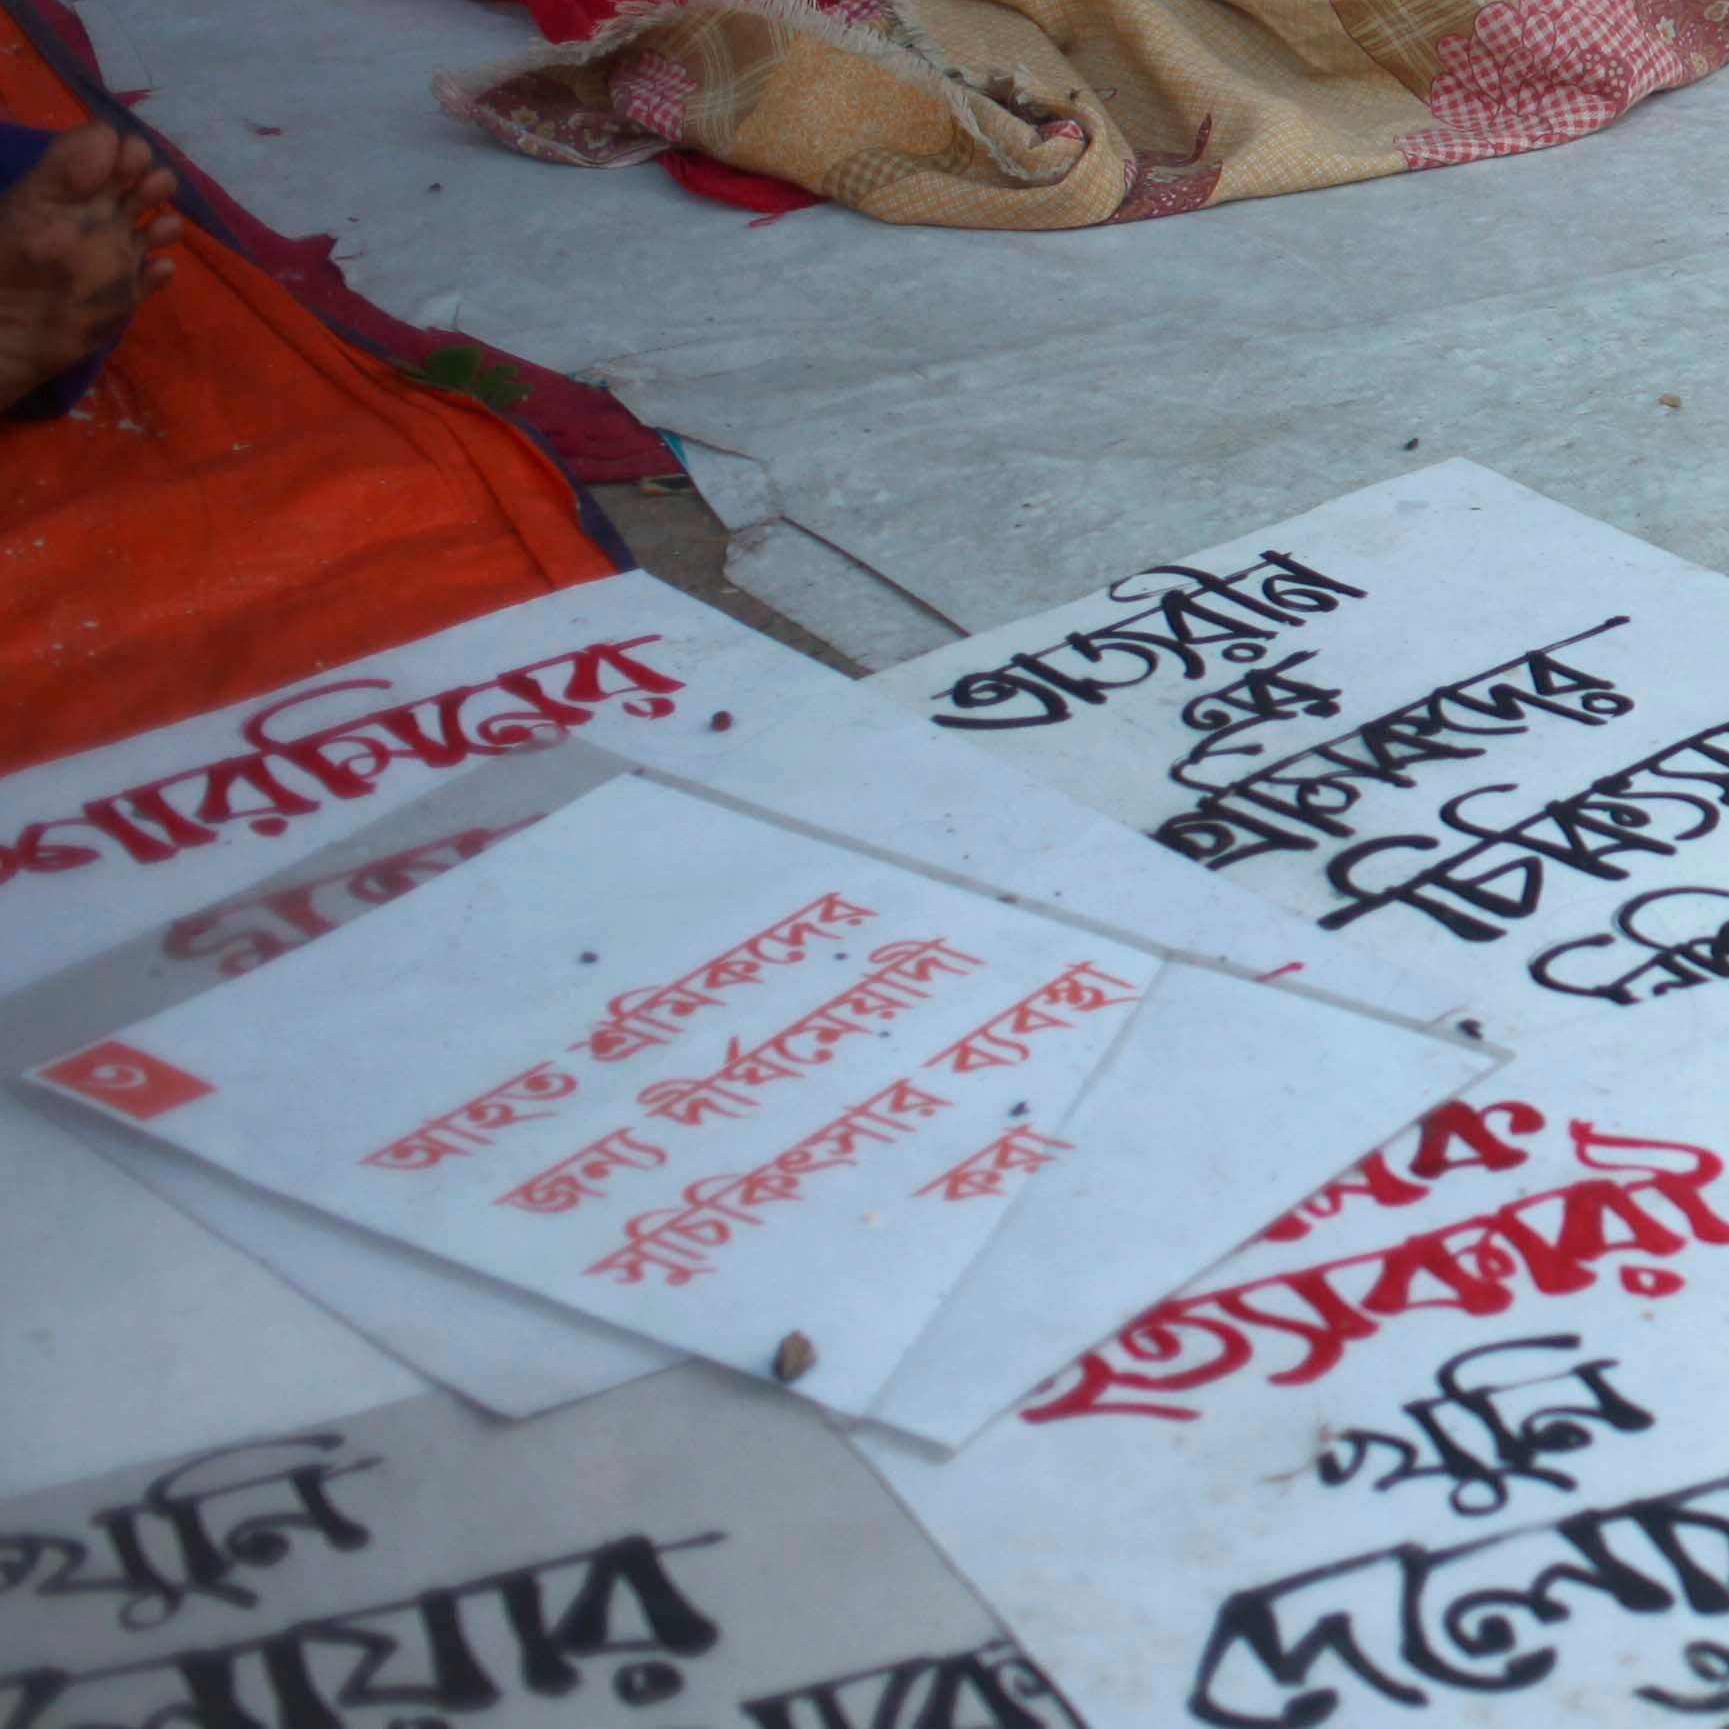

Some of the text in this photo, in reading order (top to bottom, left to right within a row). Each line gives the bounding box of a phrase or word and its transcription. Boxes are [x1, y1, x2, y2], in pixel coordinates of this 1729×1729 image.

[934, 547, 1368, 730] তাজরীন
[1181, 646, 1343, 751] এর
[358, 1058, 578, 1176] আহত
[568, 890, 881, 1069] শ্রমিকদের
[491, 933, 991, 1217] জন্য দীর্ঘমেয়াদী
[584, 957, 1152, 1293] সুচিকিৎসার ব্যবস্থা
[910, 1119, 1078, 1206] করা
